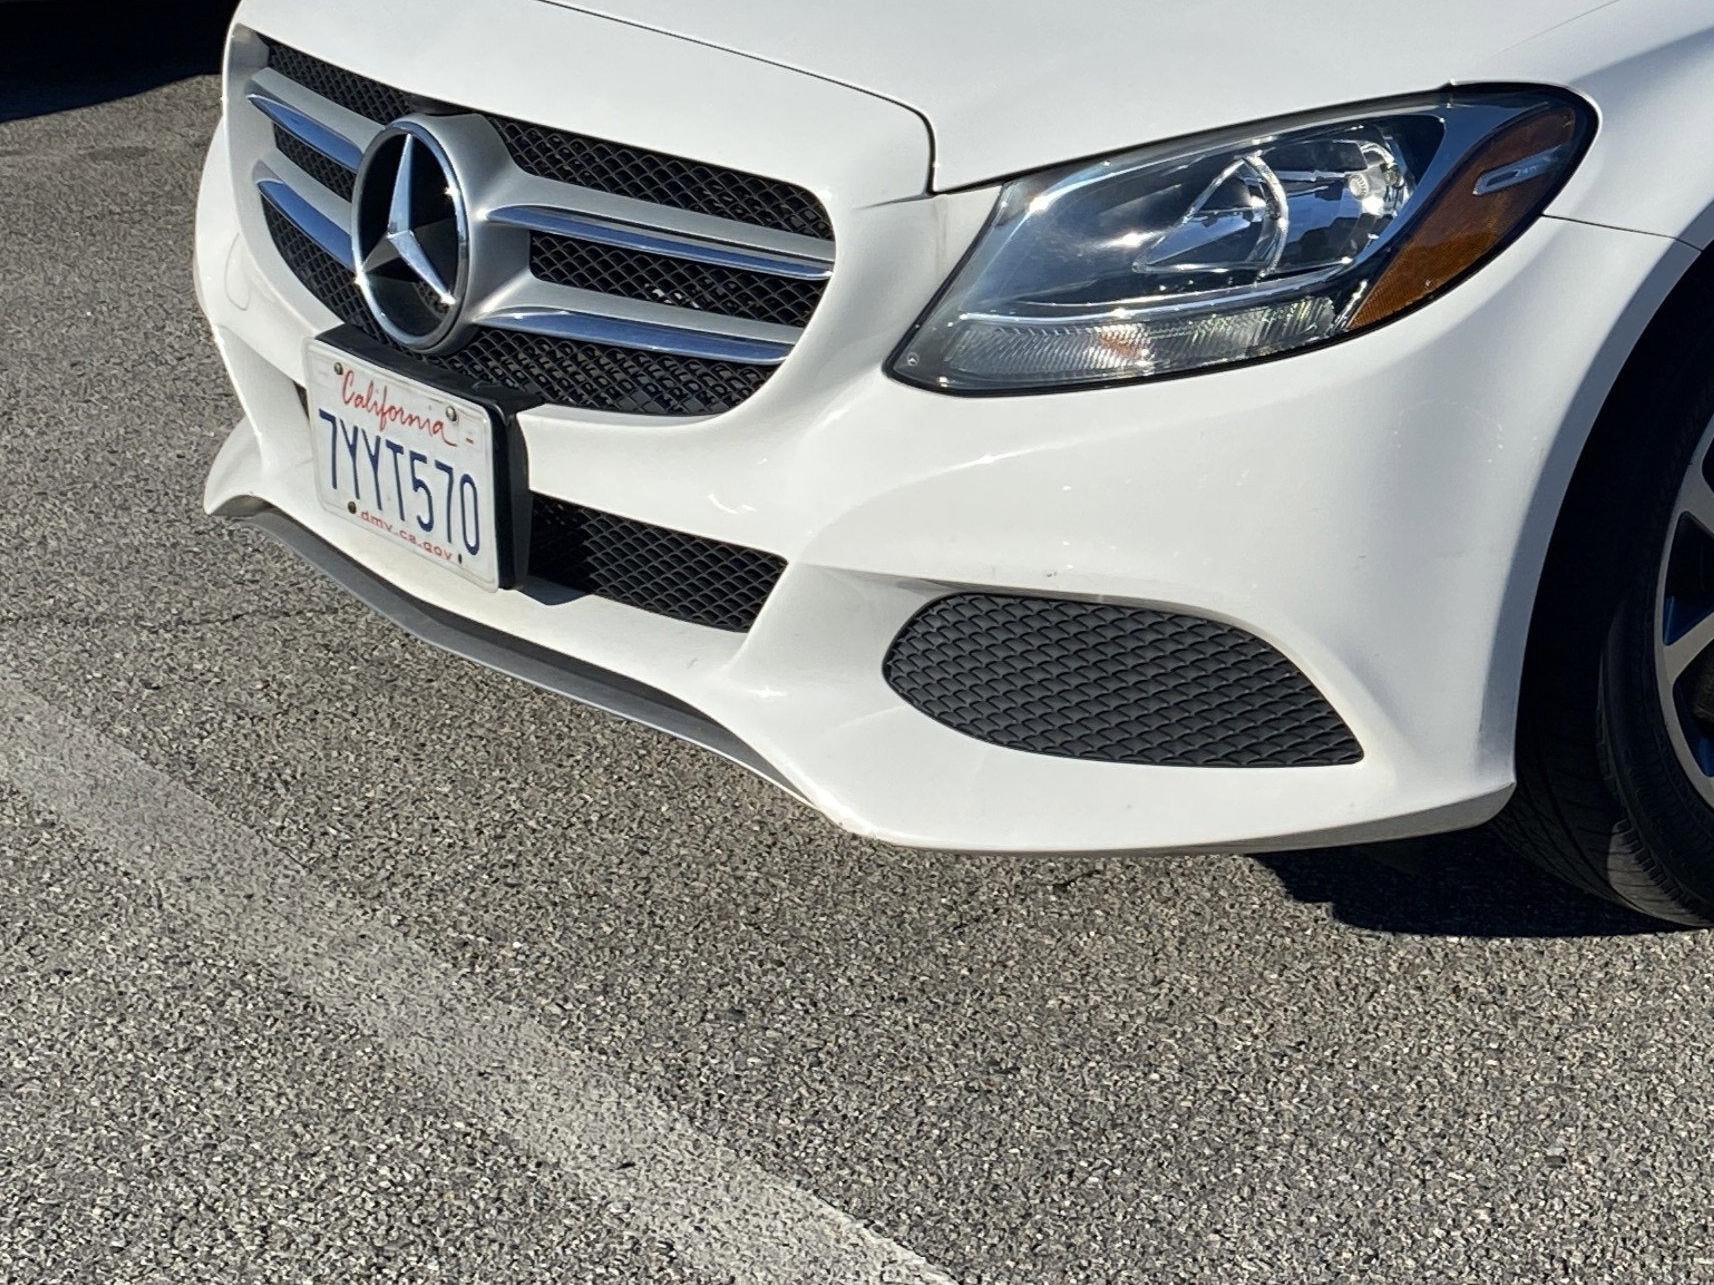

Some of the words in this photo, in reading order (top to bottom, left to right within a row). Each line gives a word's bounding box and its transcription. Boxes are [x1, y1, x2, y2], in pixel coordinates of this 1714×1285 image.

[340, 370, 457, 447] California
[318, 408, 480, 556] 7YYT570
[360, 510, 453, 561] dmv.ca.gov
